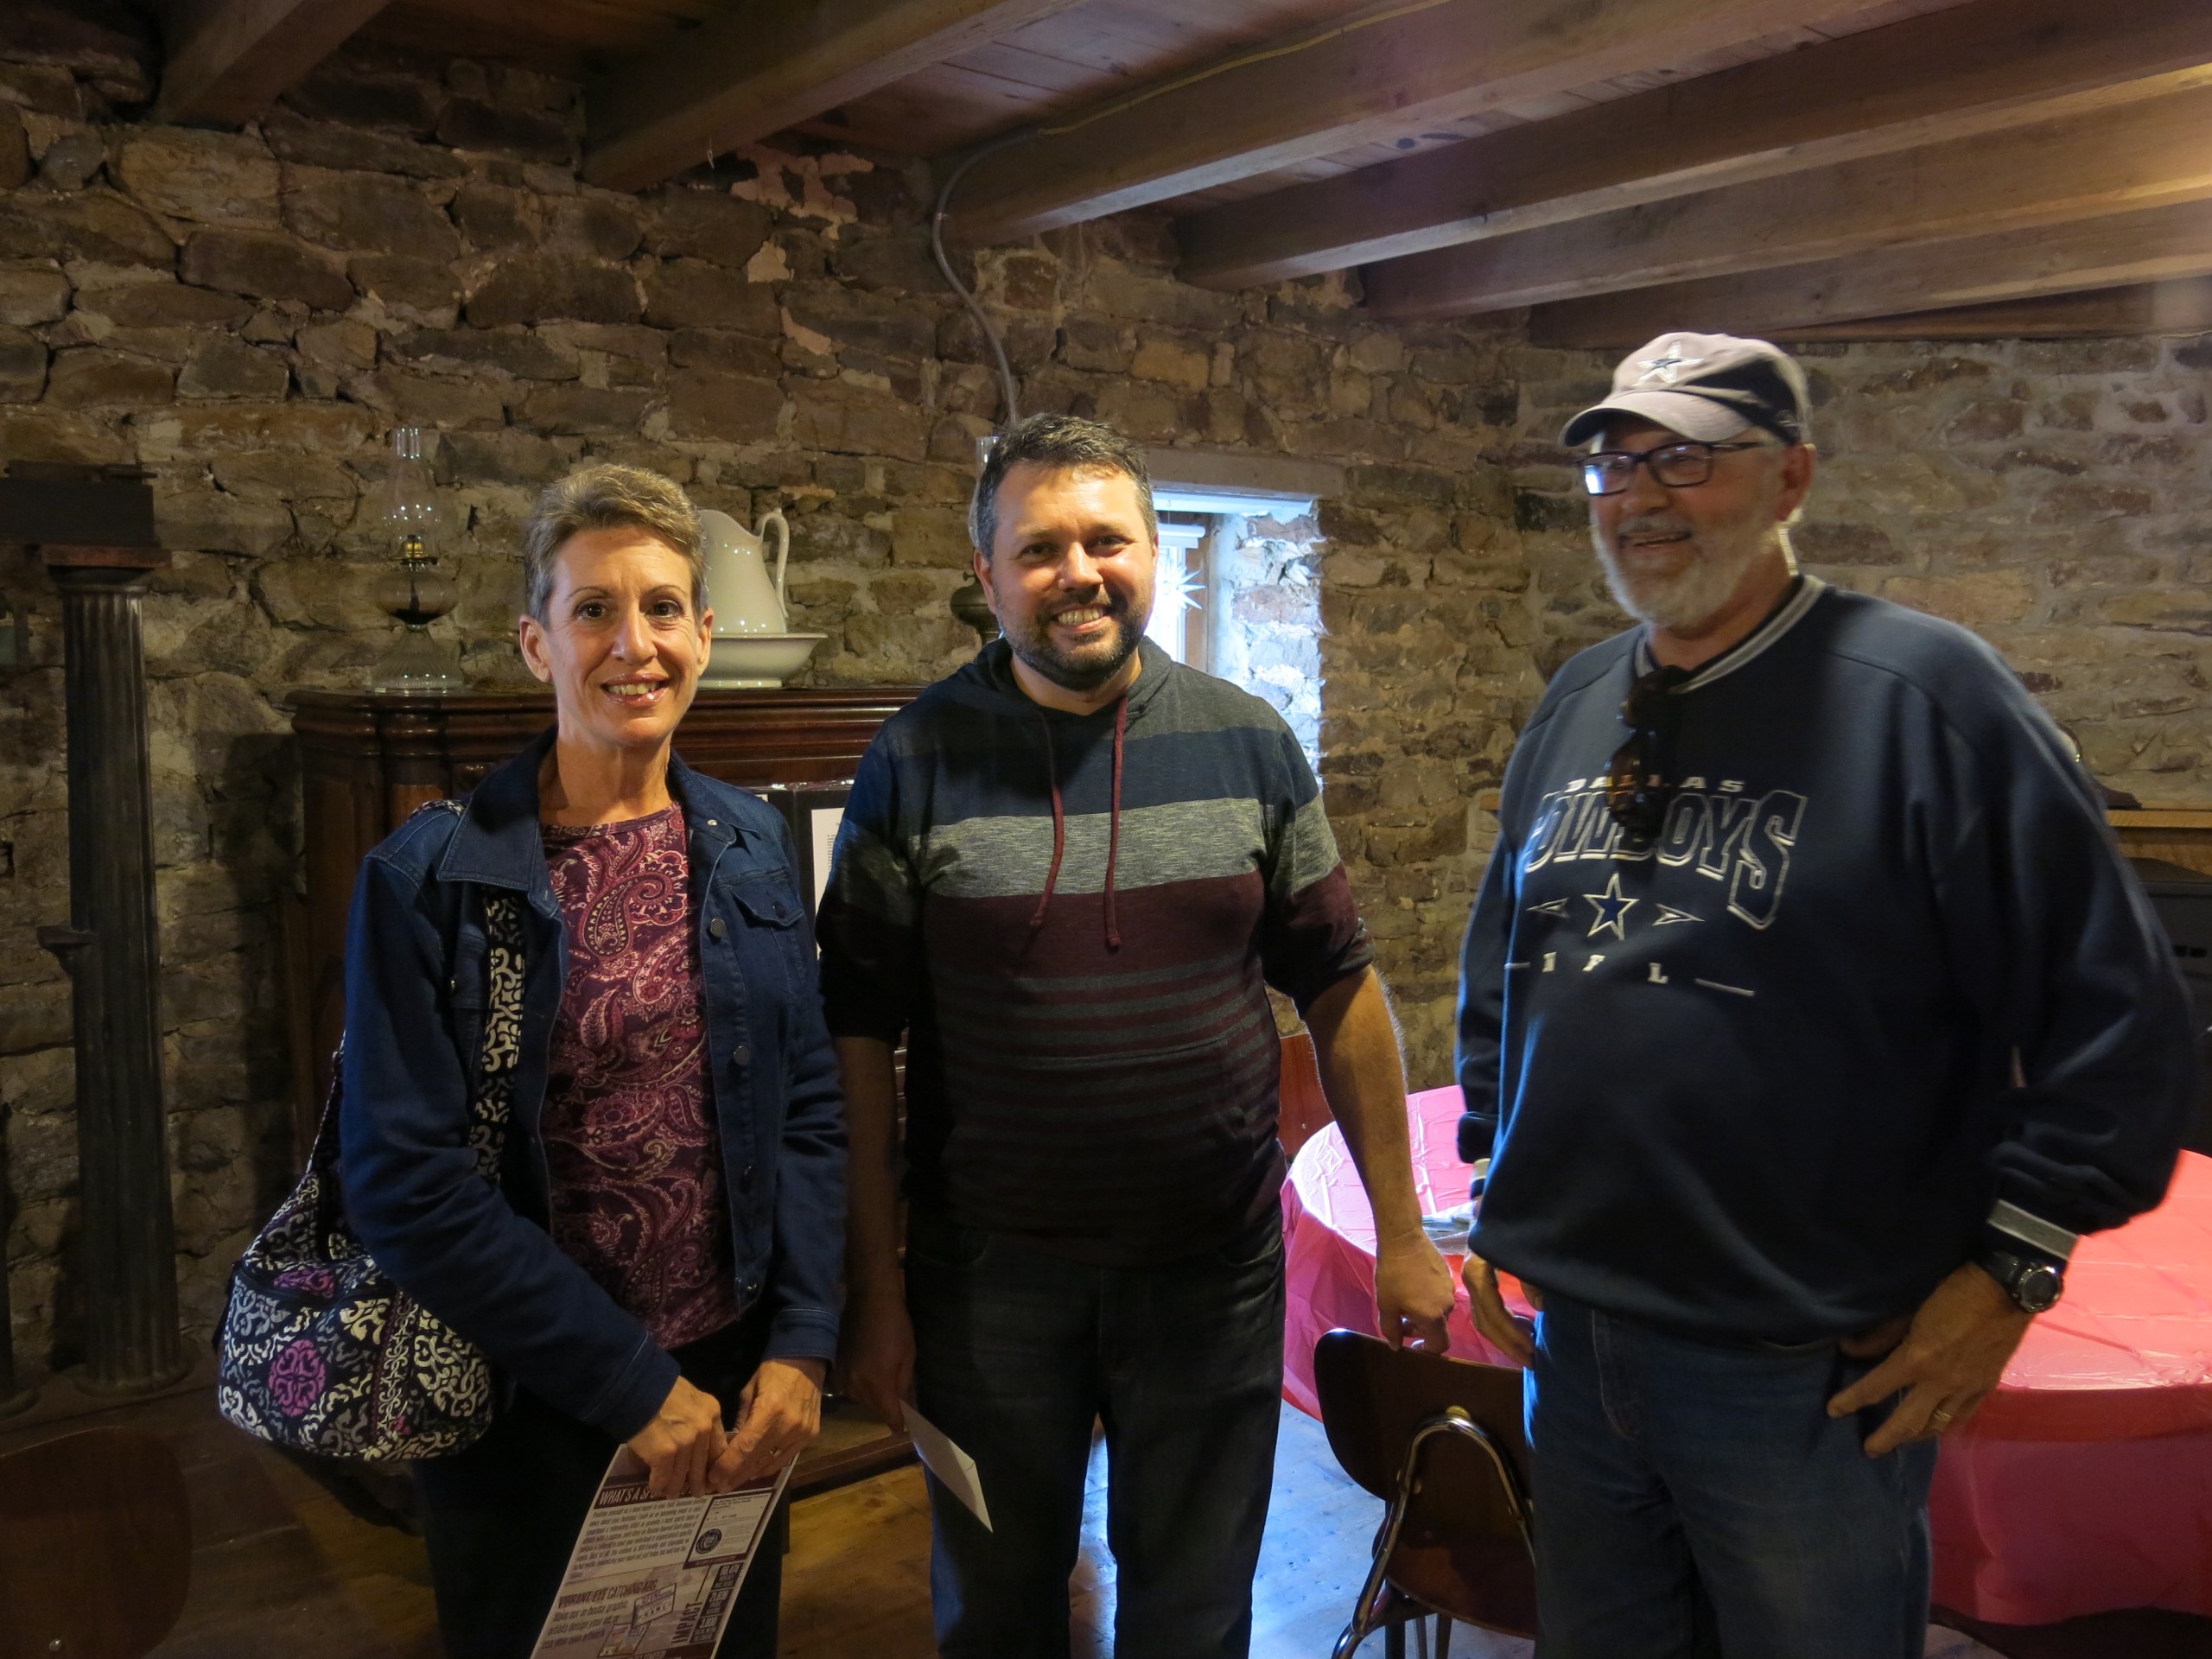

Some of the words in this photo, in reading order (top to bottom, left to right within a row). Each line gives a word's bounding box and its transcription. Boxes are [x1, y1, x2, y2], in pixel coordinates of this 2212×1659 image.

[599, 1487, 634, 1506] WHAT'S
[632, 1486, 641, 1501] A
[671, 1601, 702, 1644] IMPACT
